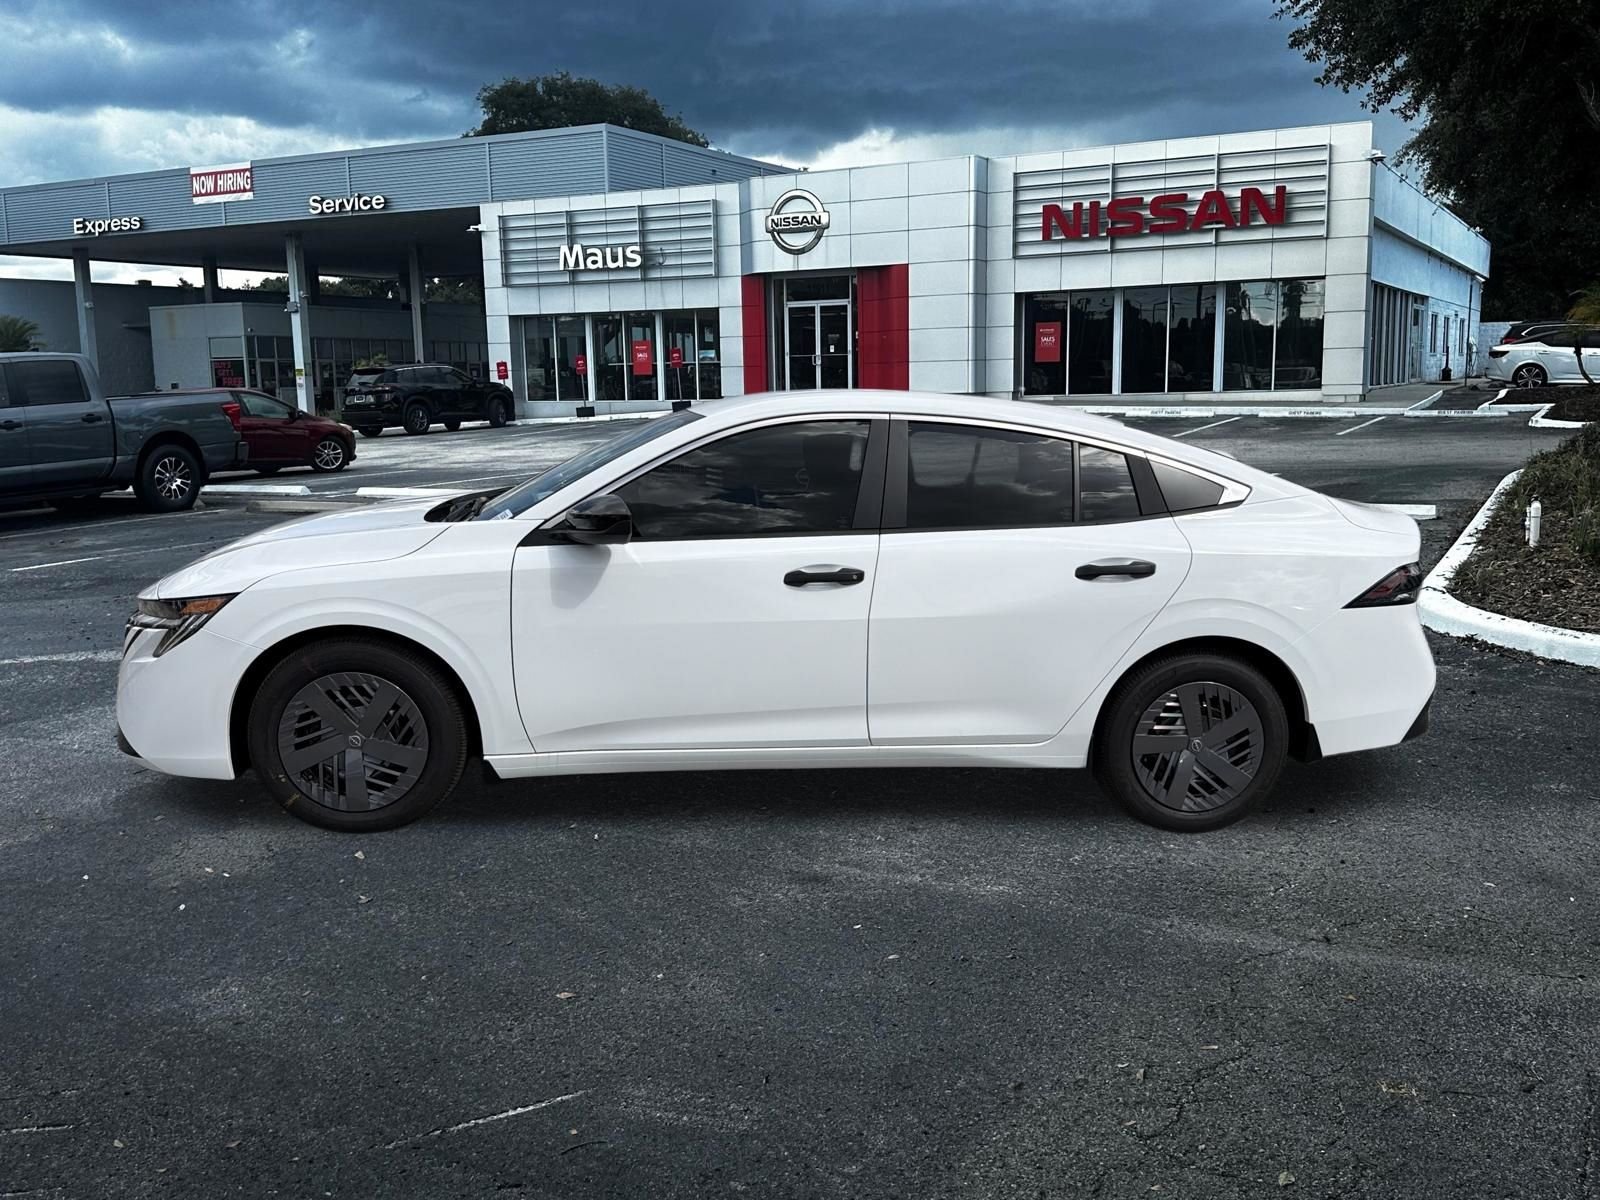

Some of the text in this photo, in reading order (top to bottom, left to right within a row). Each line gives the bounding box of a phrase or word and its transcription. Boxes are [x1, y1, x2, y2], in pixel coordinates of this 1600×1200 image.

[192, 171, 251, 195] NOW HIRING
[308, 192, 386, 215] Service
[1041, 184, 1287, 241] NISSAN
[72, 215, 141, 236] Express
[770, 214, 822, 228] NISSAN
[559, 243, 642, 271] Maus
